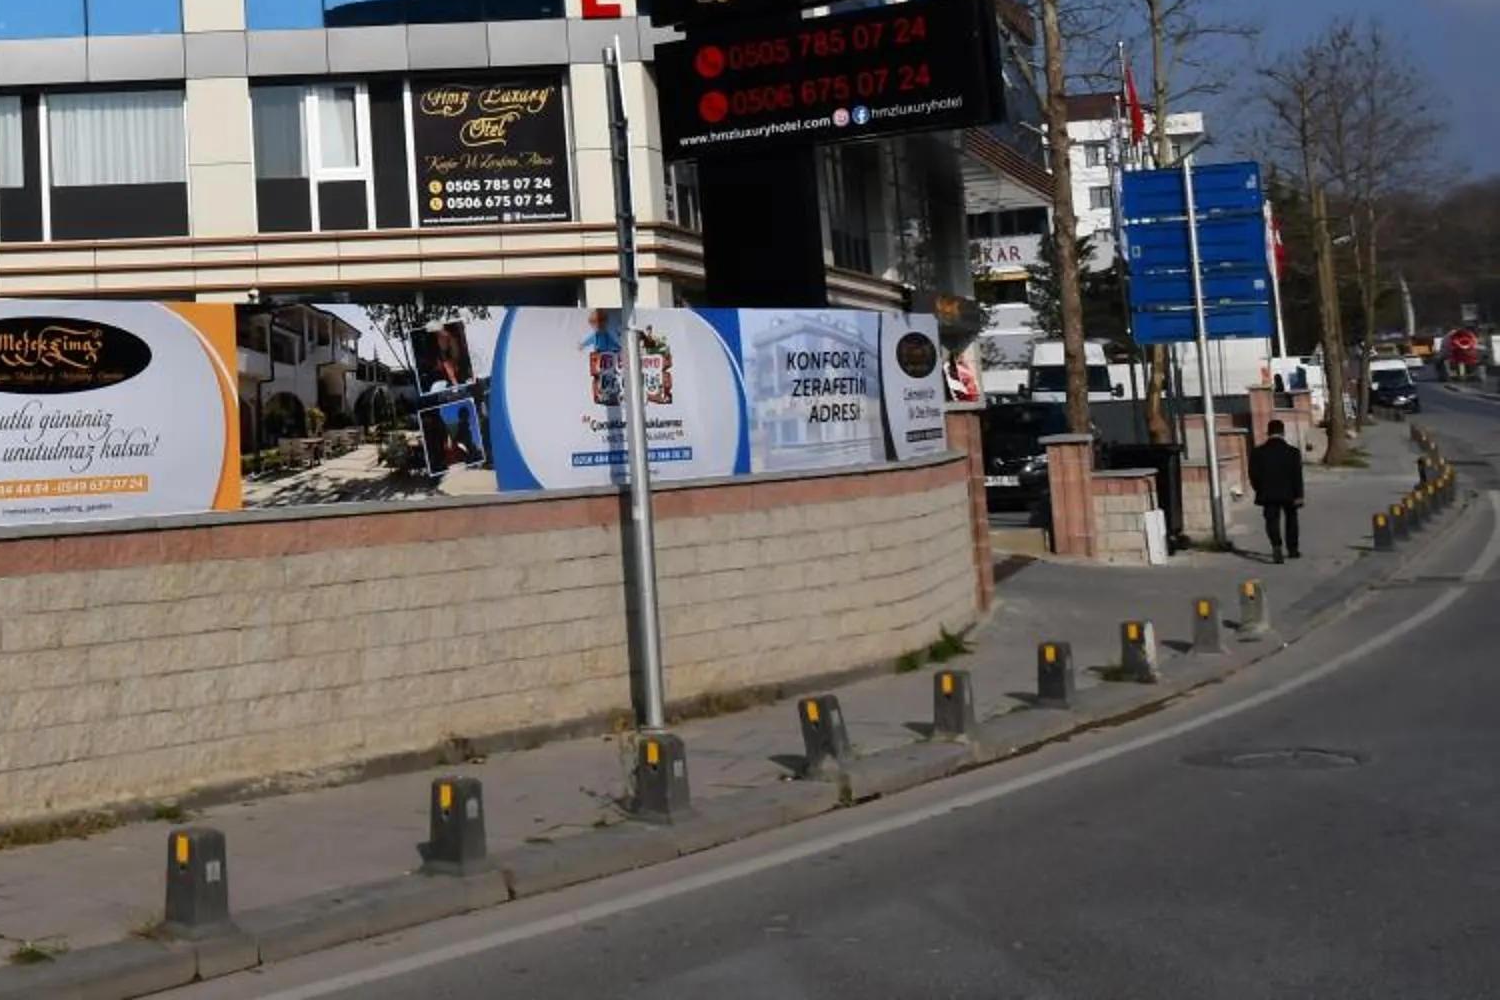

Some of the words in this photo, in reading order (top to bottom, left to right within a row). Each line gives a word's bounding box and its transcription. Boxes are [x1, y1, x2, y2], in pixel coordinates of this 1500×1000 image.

[852, 23, 883, 50] 07
[893, 16, 926, 44] 24
[857, 70, 889, 97] 07
[899, 63, 931, 90] 24
[446, 179, 480, 191] 0505
[484, 179, 510, 191] 785
[513, 178, 531, 189] 07
[533, 177, 552, 189] 24
[447, 197, 482, 209] 0506
[485, 196, 510, 207] 675
[514, 195, 533, 206] 07
[535, 194, 553, 205] 24
[787, 351, 849, 371] KONFOR
[24, 409, 115, 444] gününüz
[1, 431, 96, 474] unutulmaz
[100, 427, 160, 459] kalsın!
